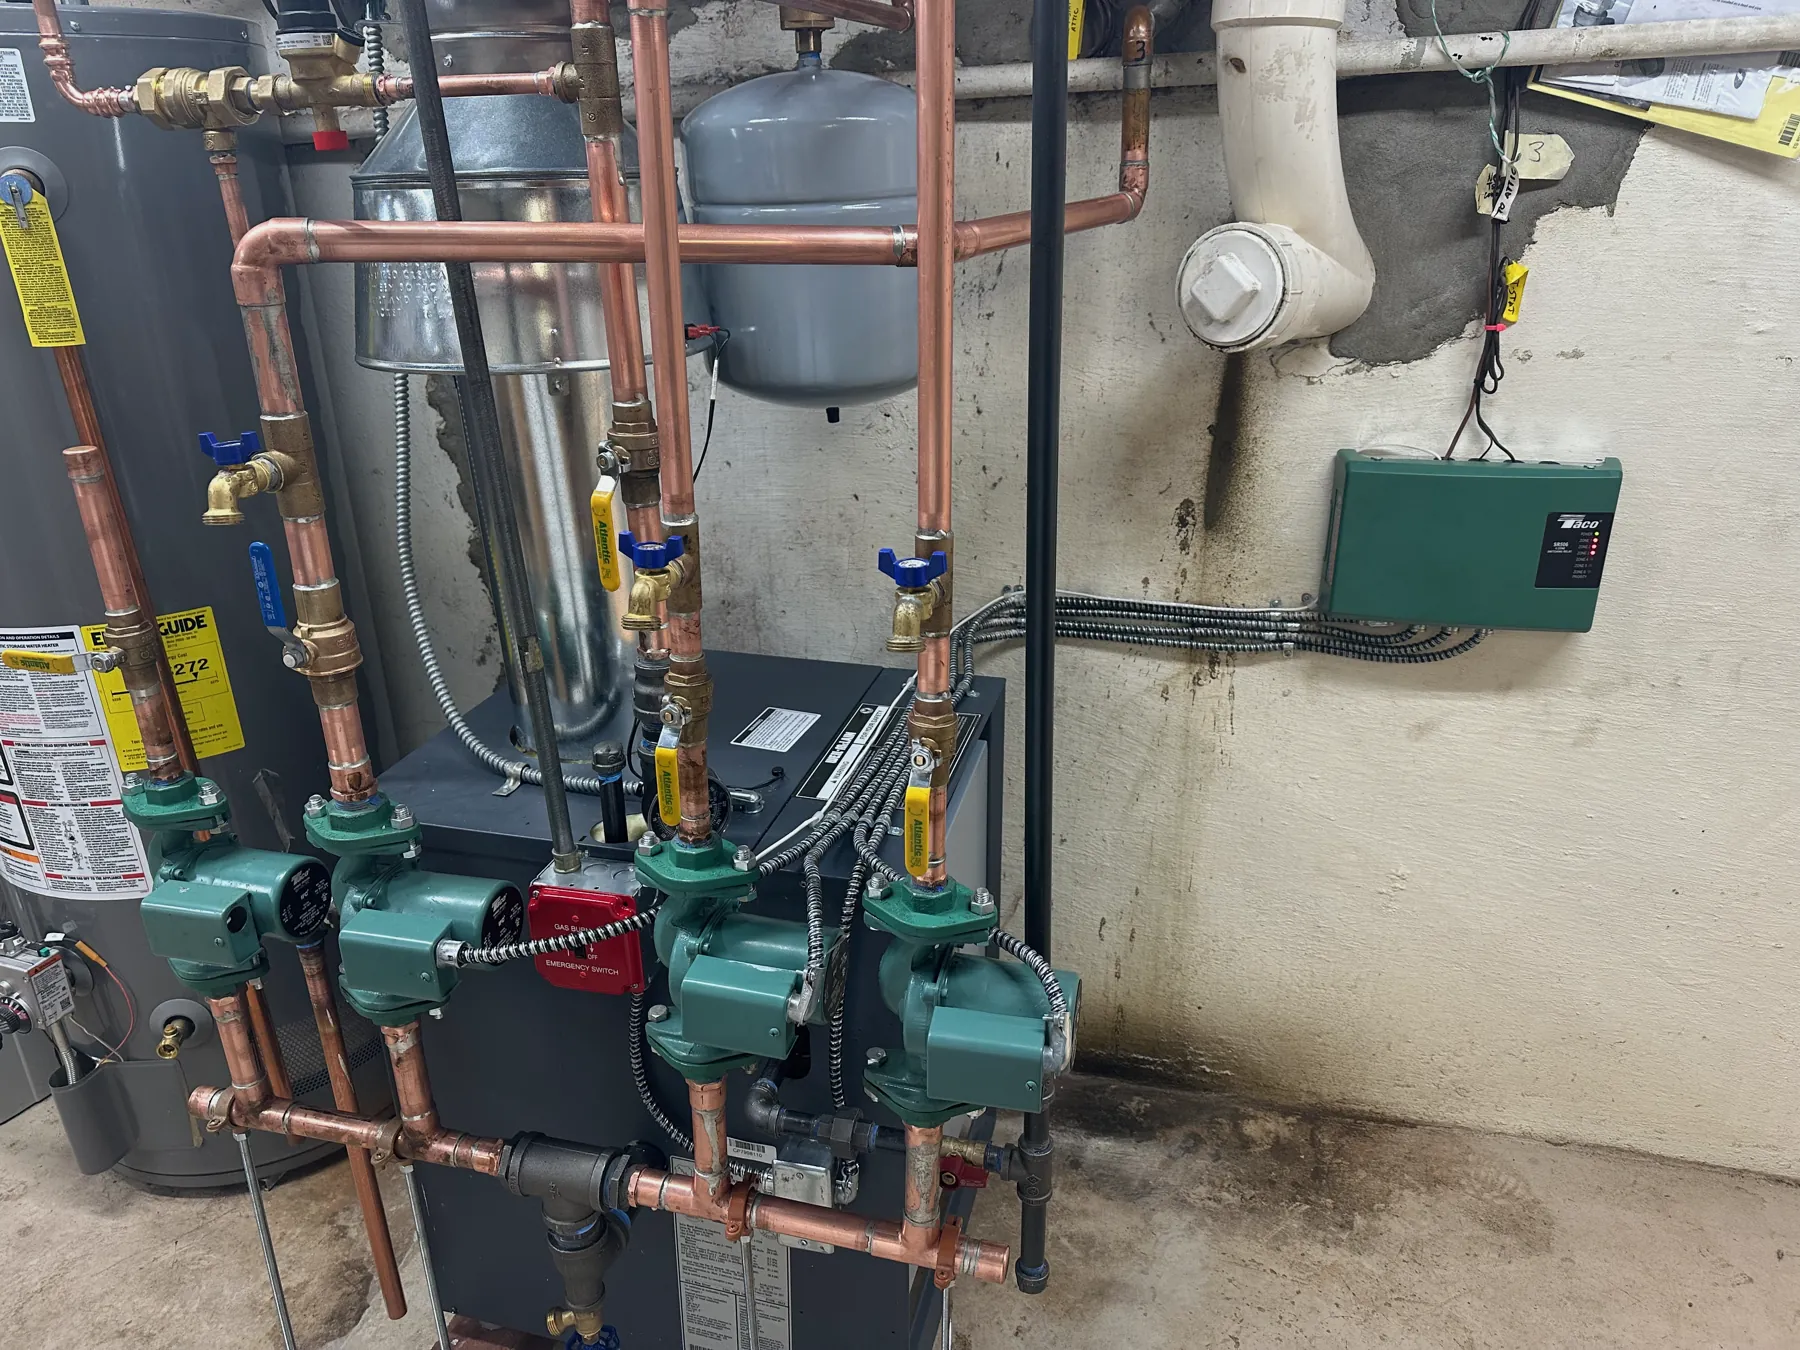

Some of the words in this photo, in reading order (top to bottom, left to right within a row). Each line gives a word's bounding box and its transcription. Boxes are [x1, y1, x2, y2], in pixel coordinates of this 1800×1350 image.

[1071, 7, 1079, 32] ATTIC
[1134, 40, 1145, 61] 3
[1528, 141, 1544, 162] 3
[1494, 202, 1505, 217] TO
[1505, 167, 1517, 199] ATTIC
[1557, 514, 1600, 529] Taco
[598, 520, 611, 565] Atlantic
[159, 614, 207, 636] GUIDE
[172, 658, 209, 676] 272
[663, 770, 673, 806] Atlantic
[914, 819, 923, 857] Atlantic
[554, 923, 570, 932] GAS
[545, 959, 590, 971] EMERGENCY
[591, 965, 619, 976] SWITCH
